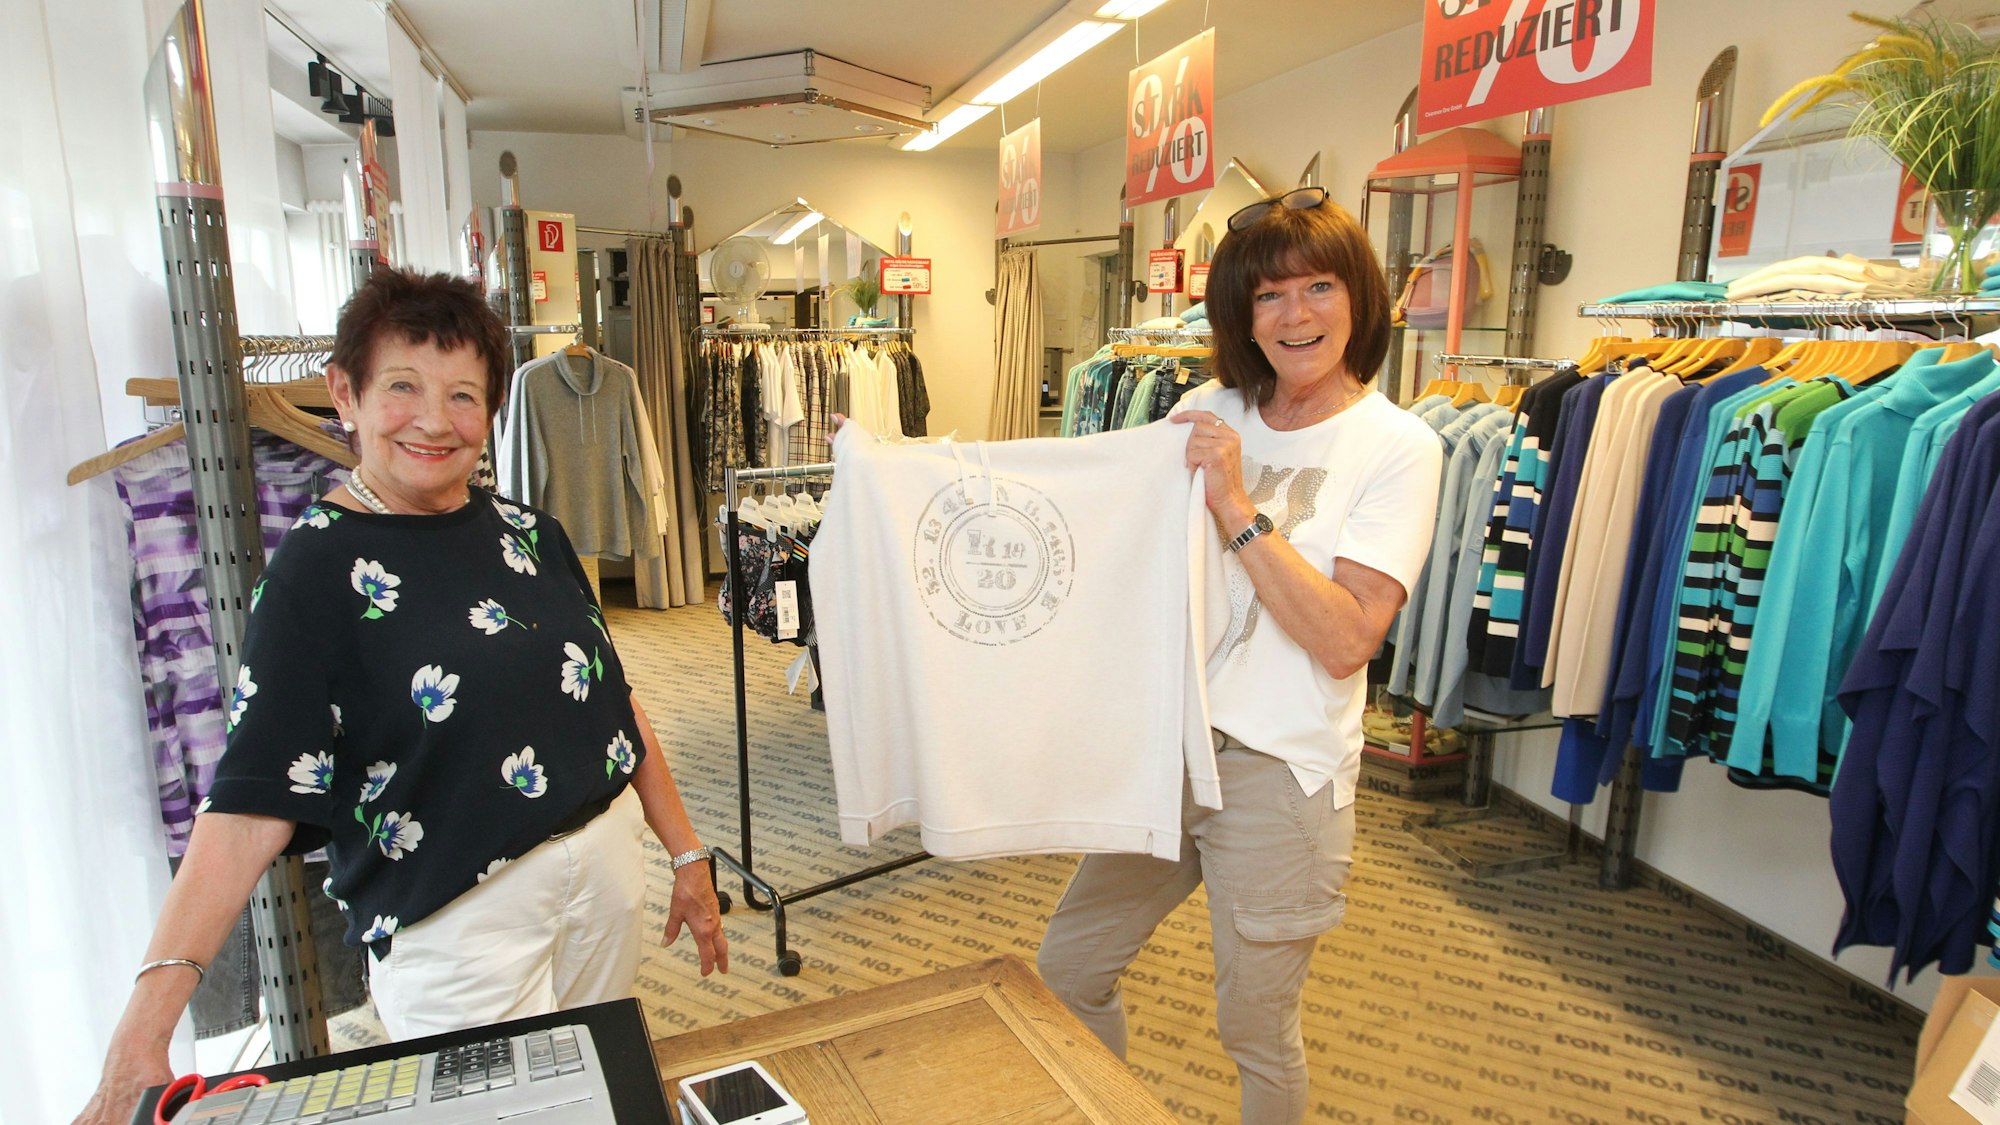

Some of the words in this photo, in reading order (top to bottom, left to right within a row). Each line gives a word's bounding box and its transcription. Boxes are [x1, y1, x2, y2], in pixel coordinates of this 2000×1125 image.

[1134, 82, 1203, 139] STARK
[1132, 131, 1203, 176] REDUZIERT
[978, 569, 1017, 590] 20
[953, 610, 1028, 635] LOVE
[887, 887, 929, 902] NO.1
[943, 888, 987, 904] NO.1
[1000, 891, 1043, 906] NO.1
[801, 906, 844, 923] NO.1
[1398, 897, 1443, 913] NO.1
[1455, 899, 1499, 914] NO.1
[1511, 899, 1557, 915] NO.1
[1568, 900, 1613, 916] NO.1
[1625, 900, 1670, 916] NO.1
[859, 908, 902, 924] NO.1
[916, 910, 961, 927] NO.1
[975, 912, 1020, 929] NO.1
[1389, 920, 1436, 936] NO.1
[1448, 921, 1494, 937] NO.1
[1507, 922, 1554, 938] NO.1
[1566, 922, 1612, 939] NO.1
[1625, 924, 1672, 940] NO.1
[1683, 924, 1731, 940] NO.1
[828, 930, 873, 948] NO.1
[888, 933, 935, 951] NO.1
[949, 934, 995, 952] NO.1
[1009, 936, 1043, 951] NO
[1746, 924, 1787, 960] NO.1
[1318, 944, 1366, 962] NO.1
[1380, 944, 1428, 962] NO.1
[1441, 944, 1489, 962] NO.1
[1502, 945, 1551, 963] NO.1
[1564, 947, 1612, 965] NO.1
[1625, 948, 1674, 966] NO.1
[1686, 948, 1736, 966] NO.1
[857, 956, 905, 976] NO.1
[692, 978, 741, 999] NO.1
[1369, 970, 1420, 990] NO.1
[1433, 971, 1483, 990] NO.1
[1496, 971, 1547, 991] NO.1
[1562, 973, 1612, 992] NO.1
[1624, 974, 1676, 994] NO.1
[1688, 975, 1741, 994] NO.1
[1752, 976, 1806, 995] NO.1
[759, 981, 807, 1002] NO.1
[1155, 995, 1206, 1016] NO.1
[1357, 999, 1410, 1020] NO.1
[1425, 1000, 1478, 1021] NO.1
[1491, 1001, 1545, 1022] NO.1
[1558, 1001, 1611, 1022] NO.1
[1625, 1003, 1678, 1024] NO.1
[1690, 1004, 1745, 1025] NO.1
[1757, 1004, 1814, 1026] NO.1
[1823, 1004, 1882, 1026] NO.1
[1133, 1025, 1187, 1049] NO.1
[1344, 1030, 1400, 1053] NO.1
[1416, 1031, 1471, 1055] NO.1
[1485, 1032, 1541, 1056] NO.1
[1555, 1032, 1610, 1055] NO.1
[1625, 1034, 1681, 1057] NO.1
[1694, 1035, 1752, 1058] NO.1
[1763, 1036, 1823, 1059] NO.1
[1831, 1036, 1894, 1059] NO.1
[1330, 1064, 1388, 1090] NO.1
[1405, 1066, 1463, 1091] NO.1
[1478, 1067, 1537, 1092] NO.1
[1552, 1067, 1610, 1093] NO.1
[1625, 1068, 1684, 1094] NO.1
[1697, 1069, 1759, 1095] NO.1
[1770, 1070, 1834, 1095] NO.1
[1841, 1070, 1908, 1096] NO.1
